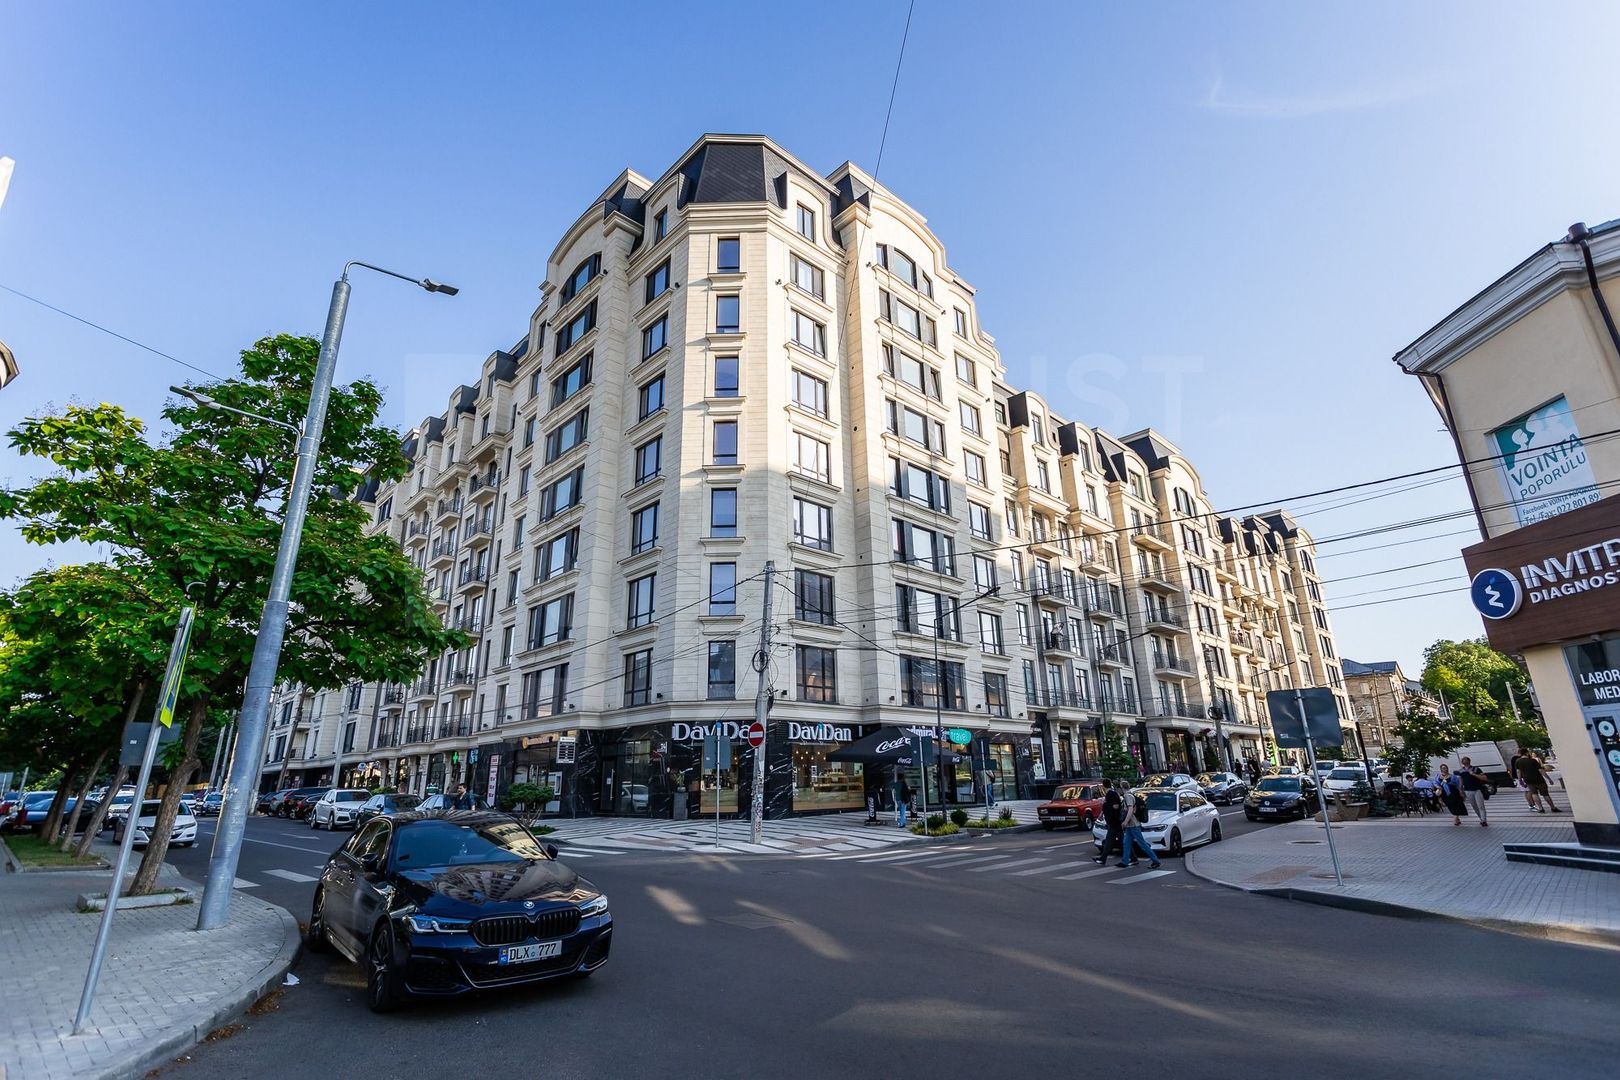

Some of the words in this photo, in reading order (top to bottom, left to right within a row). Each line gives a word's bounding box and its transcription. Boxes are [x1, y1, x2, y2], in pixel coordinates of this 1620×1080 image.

[1556, 502, 1571, 514] 022
[1573, 497, 1587, 508] 801
[1589, 492, 1600, 502] 89
[1529, 568, 1620, 604] DIAGNOS
[672, 721, 750, 741] DaviDa
[788, 721, 852, 741] DaviDan
[509, 946, 530, 960] DLX
[538, 943, 557, 956] 777
